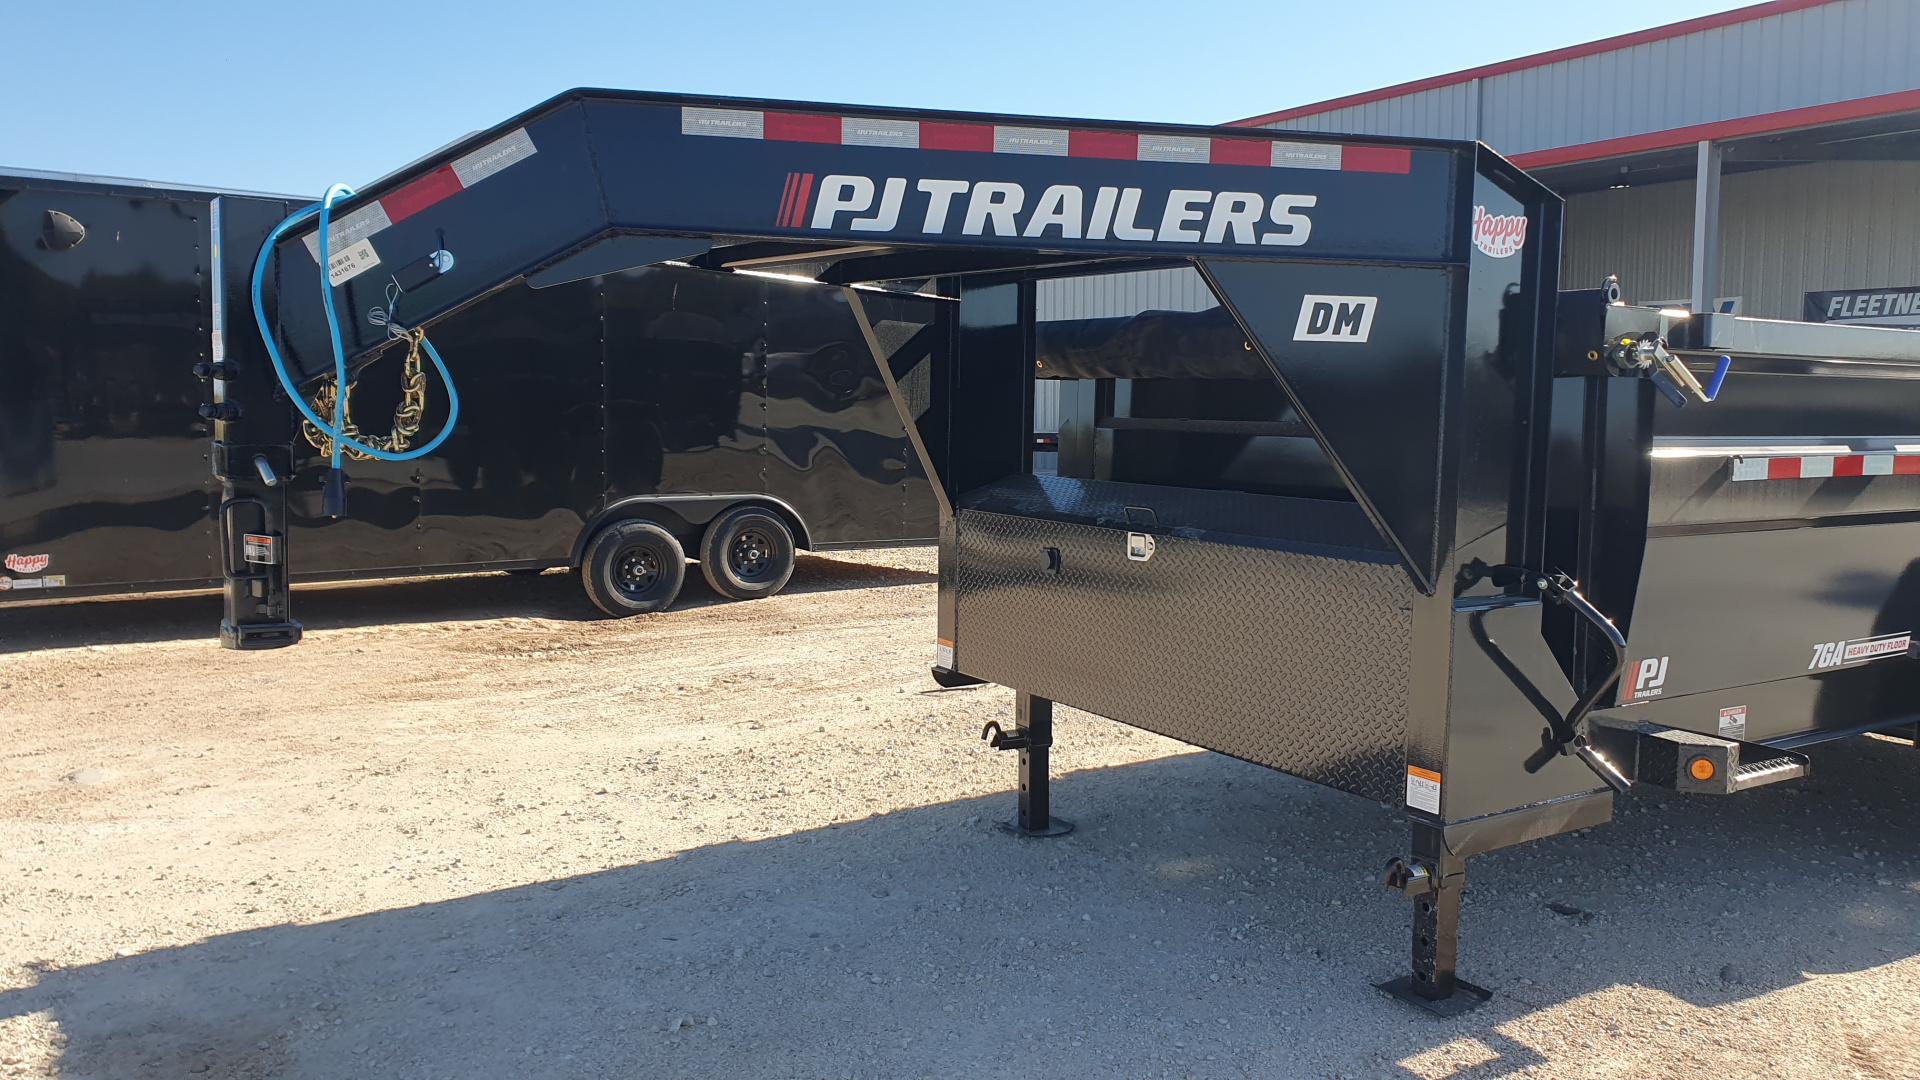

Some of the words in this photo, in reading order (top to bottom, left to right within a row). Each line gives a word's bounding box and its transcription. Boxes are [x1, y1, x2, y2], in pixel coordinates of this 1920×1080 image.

[811, 174, 907, 231] PJ
[917, 178, 1316, 246] TRAILERS
[1473, 207, 1526, 247] Happy
[1480, 240, 1513, 255] TRAILERS
[1306, 302, 1366, 336] DM
[6, 555, 48, 569] Happy
[1808, 641, 1845, 669] 7GA
[1848, 644, 1869, 656] HEAVY
[1870, 642, 1886, 653] DUTY
[1887, 639, 1907, 650] FLOOR
[1636, 656, 1669, 689] PJ
[1634, 688, 1662, 699] TRAILERS
